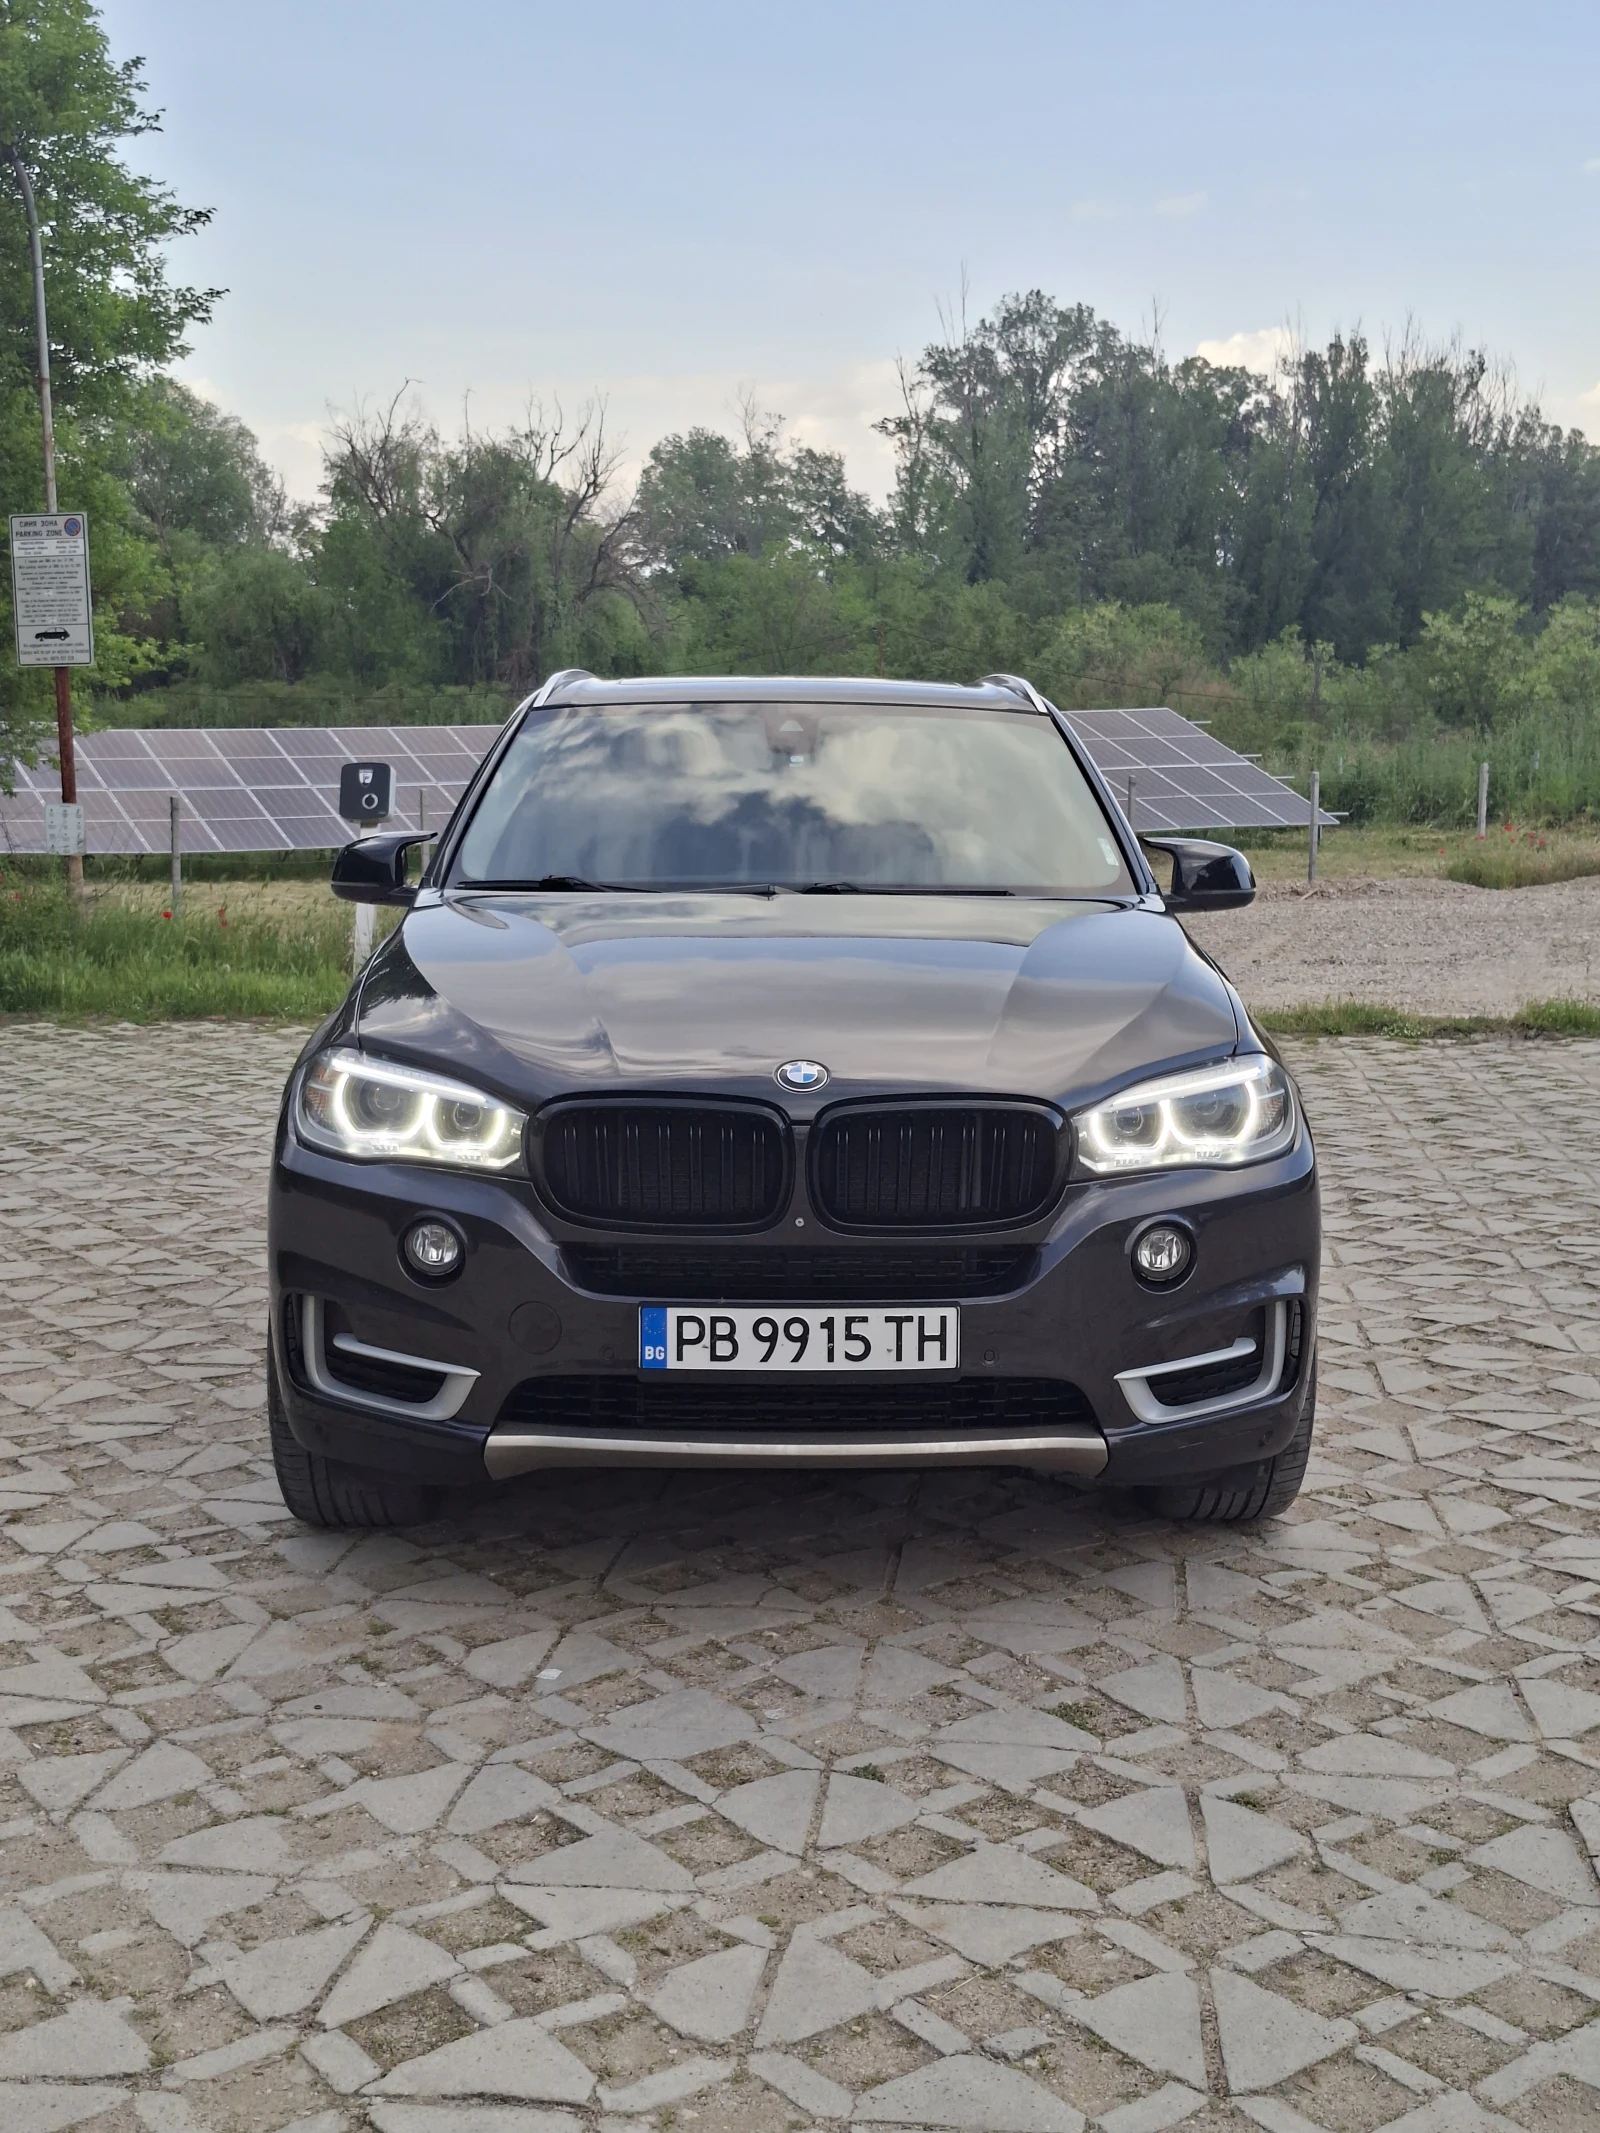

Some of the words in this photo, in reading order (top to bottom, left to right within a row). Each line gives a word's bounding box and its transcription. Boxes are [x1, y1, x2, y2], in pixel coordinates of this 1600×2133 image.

[644, 1346, 665, 1360] BG
[676, 1315, 739, 1362] PB
[752, 1315, 872, 1363] 9915
[884, 1315, 947, 1362] TH
